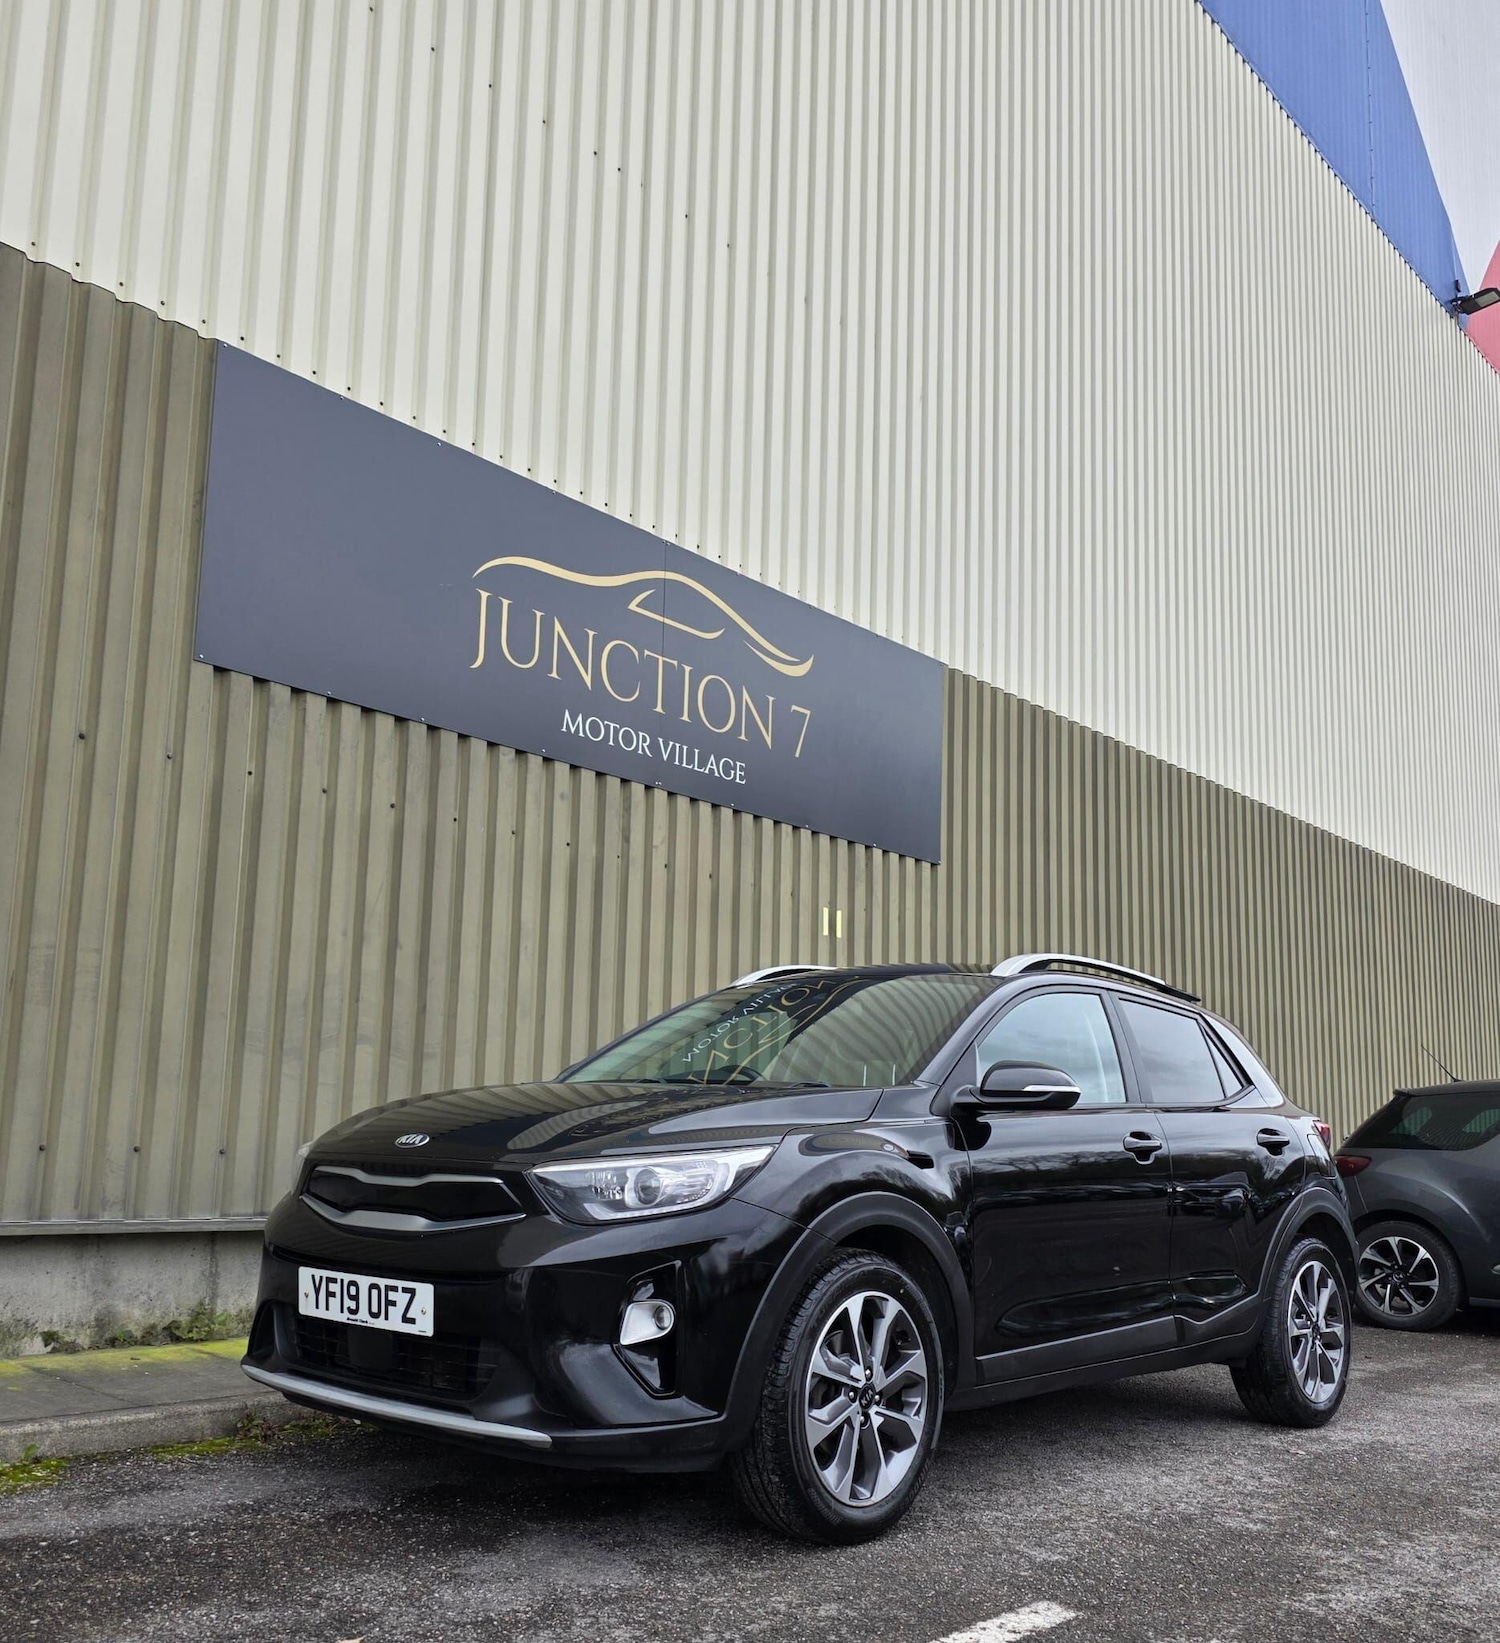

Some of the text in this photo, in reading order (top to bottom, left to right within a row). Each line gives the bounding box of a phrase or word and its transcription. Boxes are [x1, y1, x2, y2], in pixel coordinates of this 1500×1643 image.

[469, 588, 812, 758] JUNCTION 7
[561, 708, 747, 785] MOTOR VILLAGE
[397, 1134, 426, 1145] KIA
[311, 1274, 417, 1325] YF19 OFZ
[861, 1389, 874, 1407] KIA
